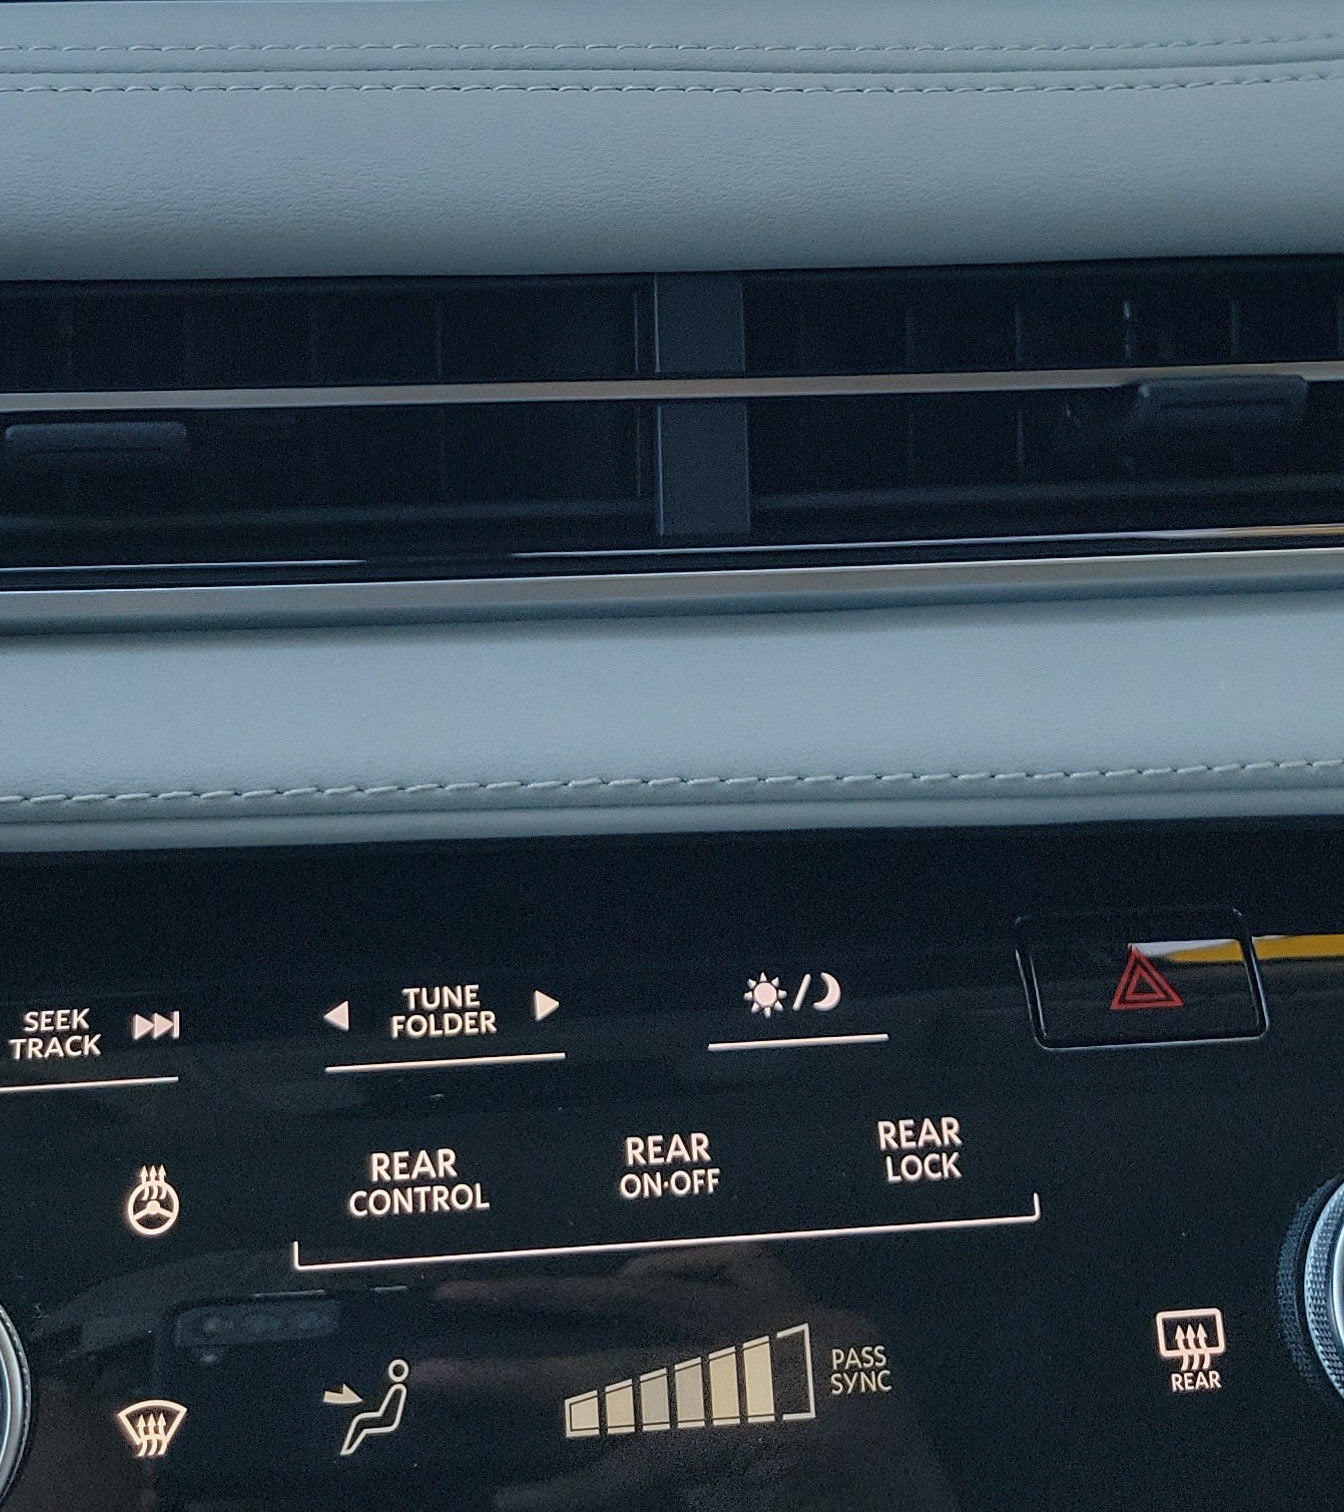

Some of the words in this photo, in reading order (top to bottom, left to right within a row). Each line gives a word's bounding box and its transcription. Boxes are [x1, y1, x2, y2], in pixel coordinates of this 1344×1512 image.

[402, 985, 480, 1010] TUNE
[23, 1008, 90, 1033] SEEK
[391, 1011, 497, 1038] FOLDER
[9, 1035, 102, 1060] TRACK
[877, 1115, 963, 1150] REAR
[625, 1132, 712, 1165] REAR
[370, 1148, 458, 1179] REAR
[885, 1151, 962, 1184] LOCK
[349, 1184, 490, 1216] CONTROL
[832, 1343, 888, 1370] PASS
[831, 1370, 893, 1395] SYNC
[1170, 1369, 1223, 1392] REAR
